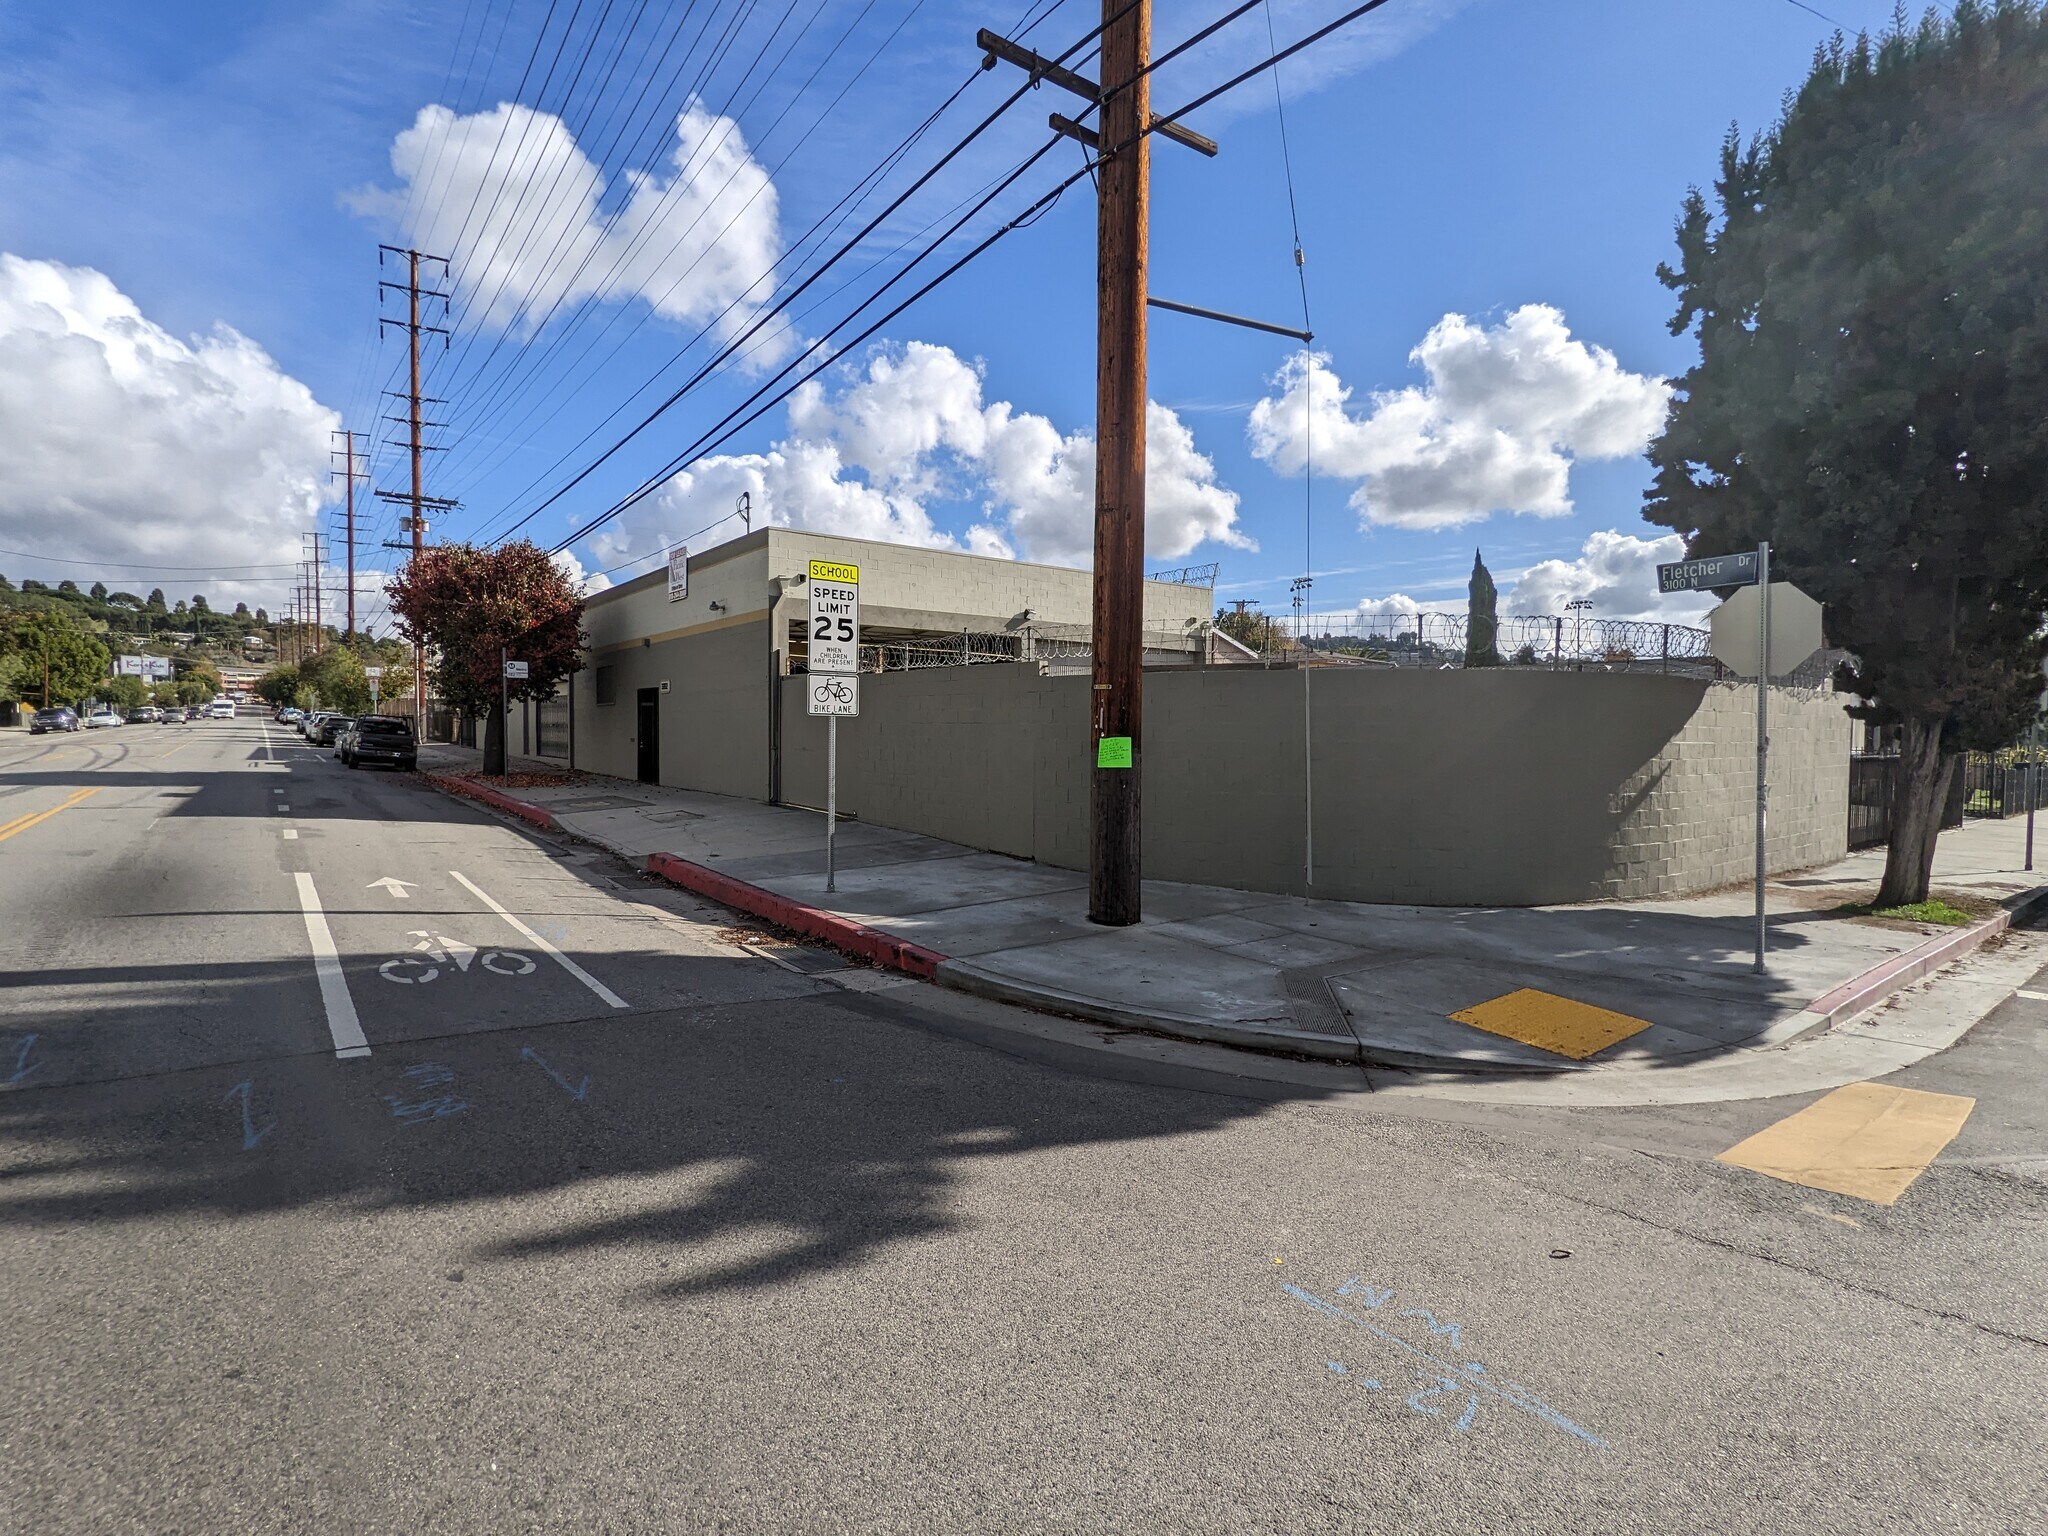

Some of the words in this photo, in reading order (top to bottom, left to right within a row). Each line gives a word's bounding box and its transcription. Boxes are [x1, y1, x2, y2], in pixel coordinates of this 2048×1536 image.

[812, 564, 856, 580] SCHOOL
[1662, 562, 1723, 580] Fletcher
[1738, 555, 1751, 566] Dr
[1663, 578, 1686, 590] 3100
[1691, 577, 1698, 587] N
[813, 587, 855, 601] SPEED
[818, 601, 851, 615] LIMIT
[813, 616, 854, 643] 25
[813, 657, 826, 665] ARE
[819, 652, 848, 660] CHILDREN
[814, 704, 831, 713] BIKE
[833, 705, 852, 713] LANE
